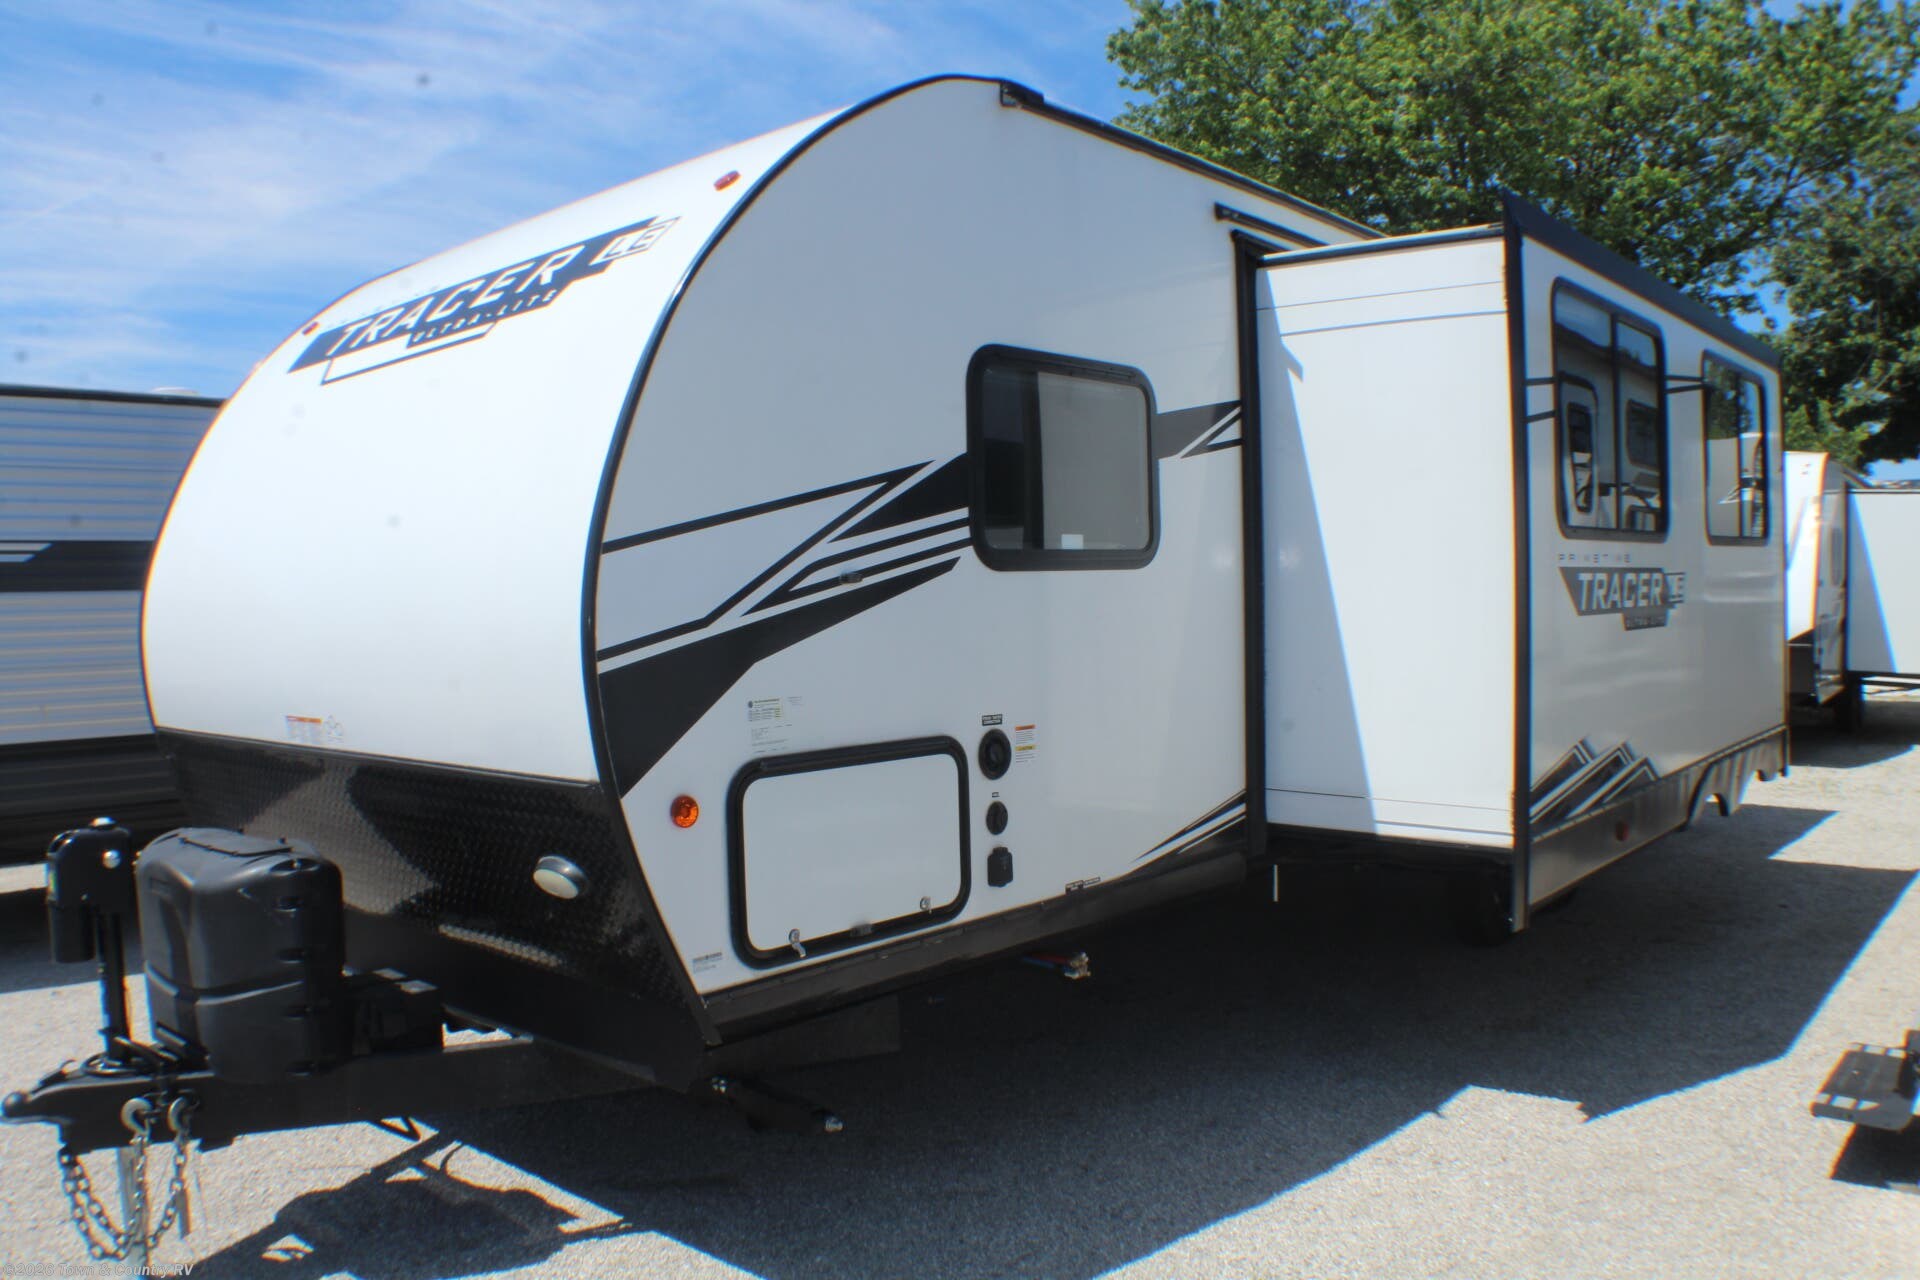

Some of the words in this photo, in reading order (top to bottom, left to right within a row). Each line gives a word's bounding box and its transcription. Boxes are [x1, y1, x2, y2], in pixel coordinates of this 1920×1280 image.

[326, 245, 586, 357] TRACER
[412, 289, 558, 343] ULTRA-LITE
[1578, 572, 1664, 611] TRACER
